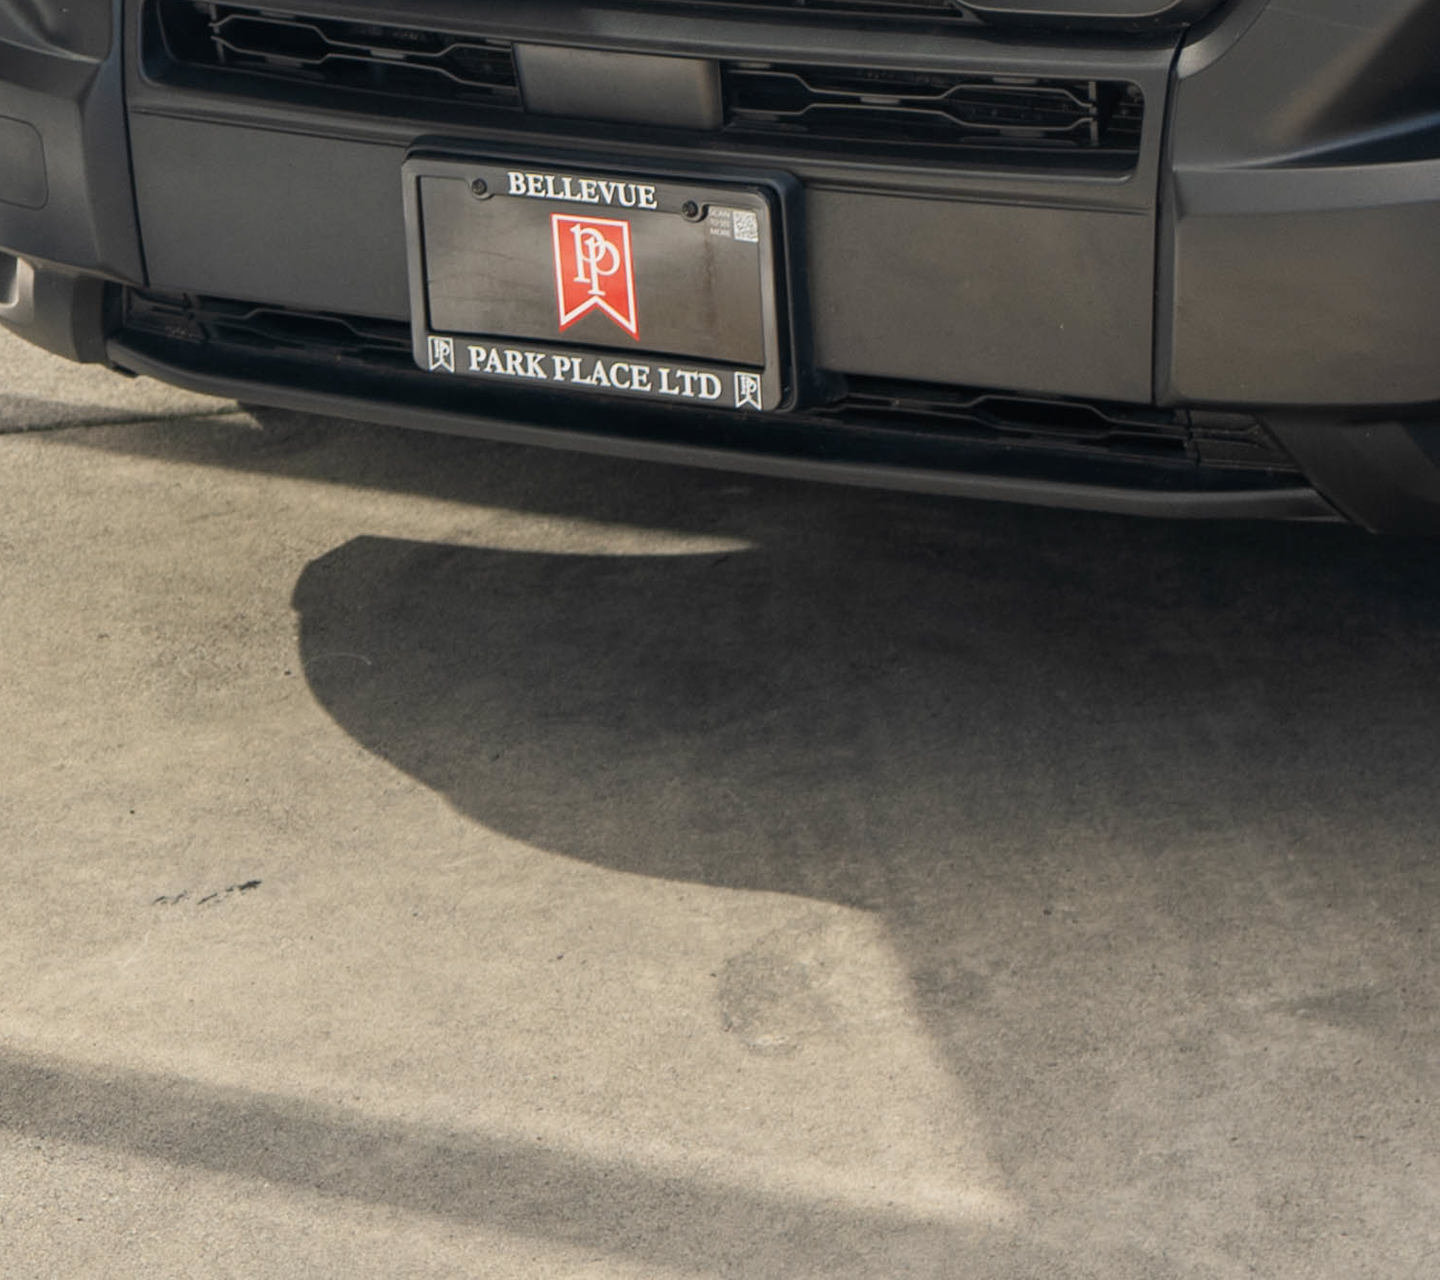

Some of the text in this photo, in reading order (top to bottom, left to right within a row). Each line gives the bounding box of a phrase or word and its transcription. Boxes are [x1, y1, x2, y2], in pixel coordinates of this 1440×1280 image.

[507, 171, 658, 209] BELLEVUE
[467, 345, 722, 400] PARK PLACE LTD
